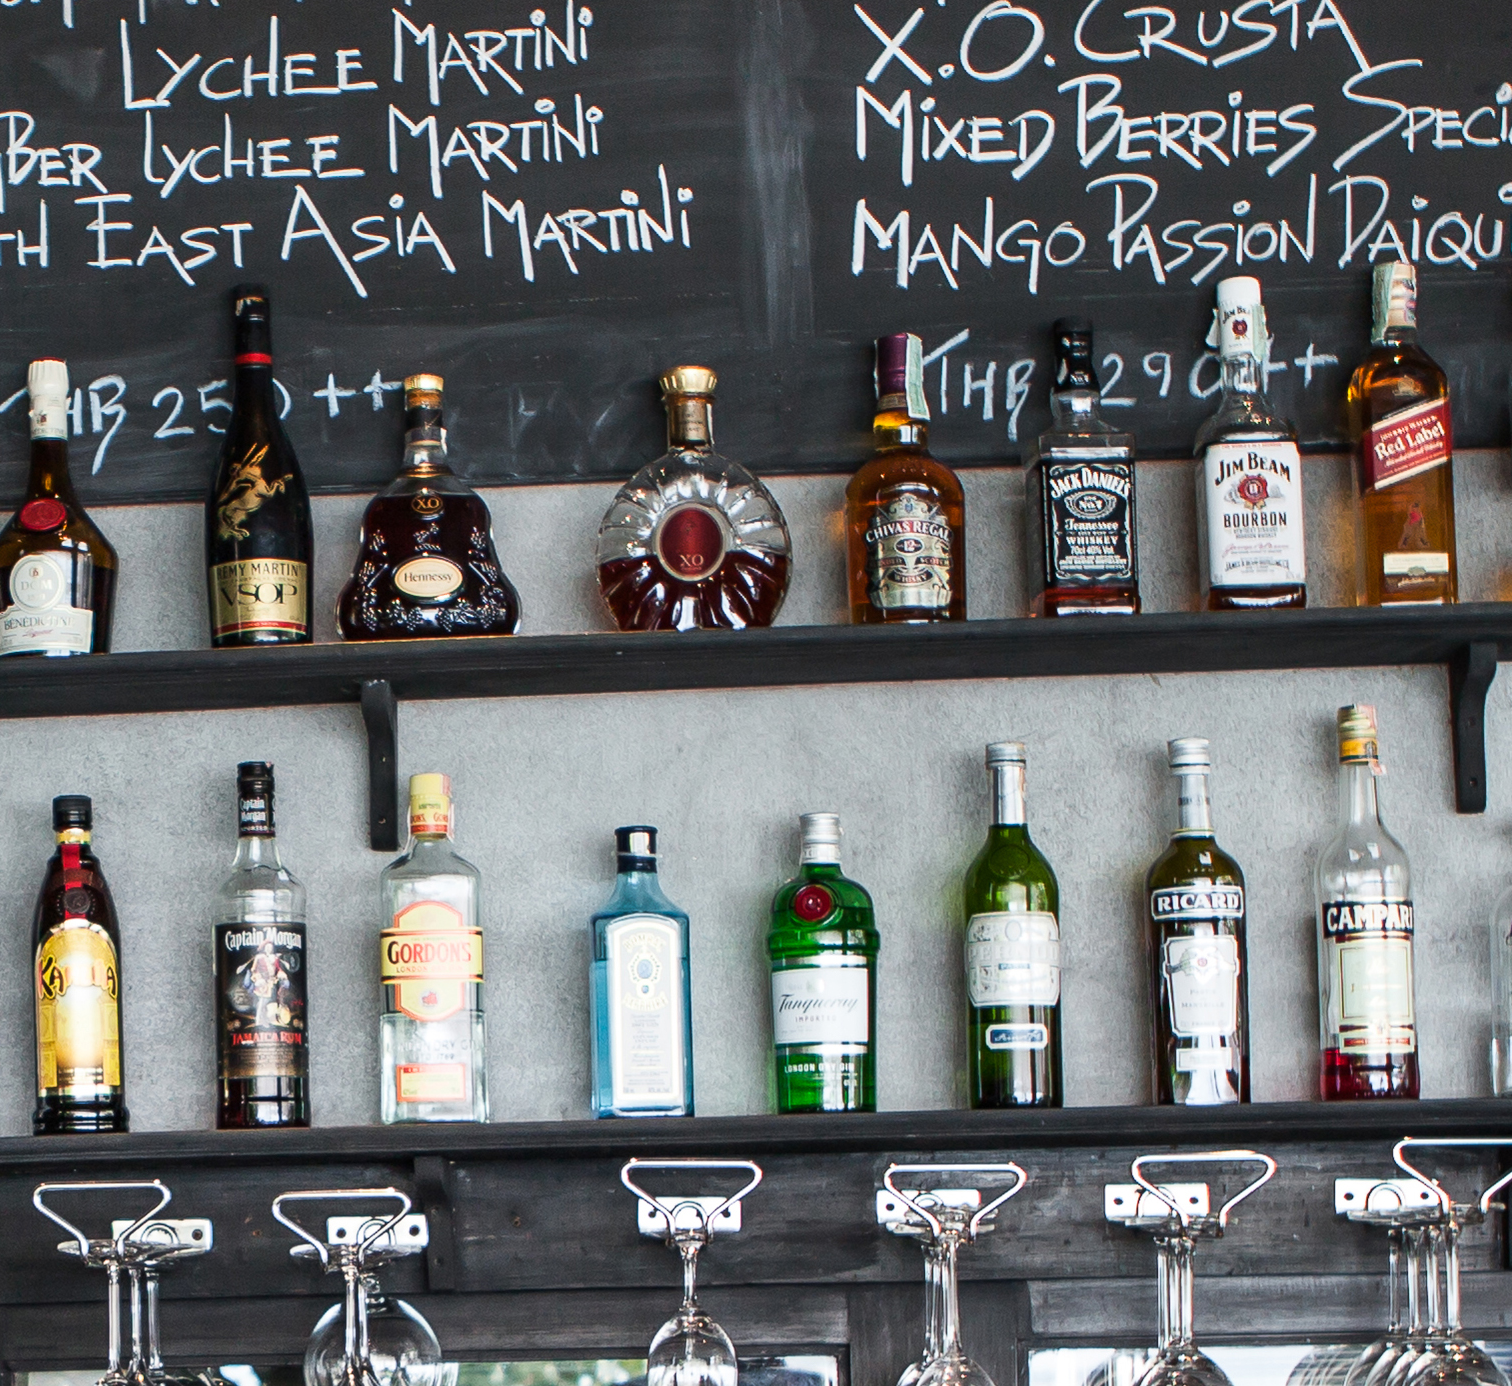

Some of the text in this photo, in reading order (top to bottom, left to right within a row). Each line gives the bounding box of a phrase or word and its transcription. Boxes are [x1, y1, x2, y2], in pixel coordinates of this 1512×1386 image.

[119, 14, 378, 110] LYCHEE
[74, 193, 254, 287] EAST
[851, 196, 1087, 296] MANGO
[1374, 435, 1407, 461] Red
[1404, 420, 1445, 448] Label
[1214, 451, 1291, 487] JIM BEAM
[1049, 471, 1082, 499] JACK
[865, 519, 950, 543] CHIVAS REGAL
[1223, 512, 1287, 528] BOURBON
[902, 539, 916, 552] 12
[678, 554, 705, 567] XO
[403, 571, 454, 584] Hennessy
[1156, 892, 1240, 913] RICARD
[1326, 903, 1414, 932] CAMPARI
[224, 926, 303, 951] Captain Morgan
[778, 993, 859, 1014] Tanqueray
[784, 1062, 816, 1074] LONDON
